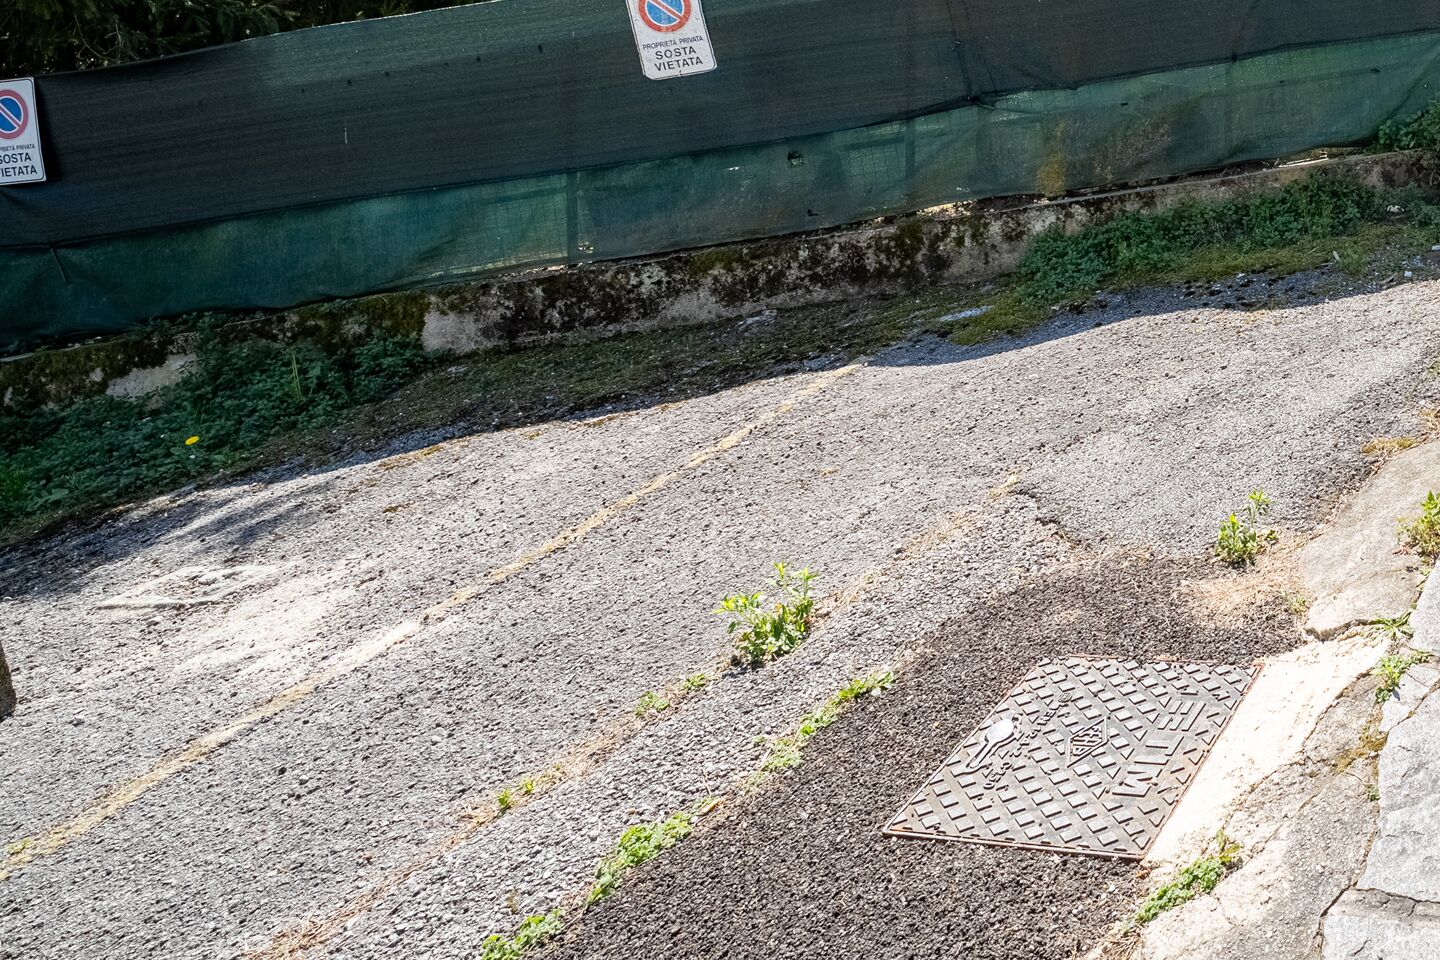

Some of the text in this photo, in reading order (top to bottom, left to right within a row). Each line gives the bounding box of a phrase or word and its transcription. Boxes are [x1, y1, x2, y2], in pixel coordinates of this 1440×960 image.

[679, 35, 703, 44] PRIVATA
[655, 46, 696, 60] SOSTA
[654, 56, 703, 72] VIETATA
[1, 165, 37, 177] IETATA
